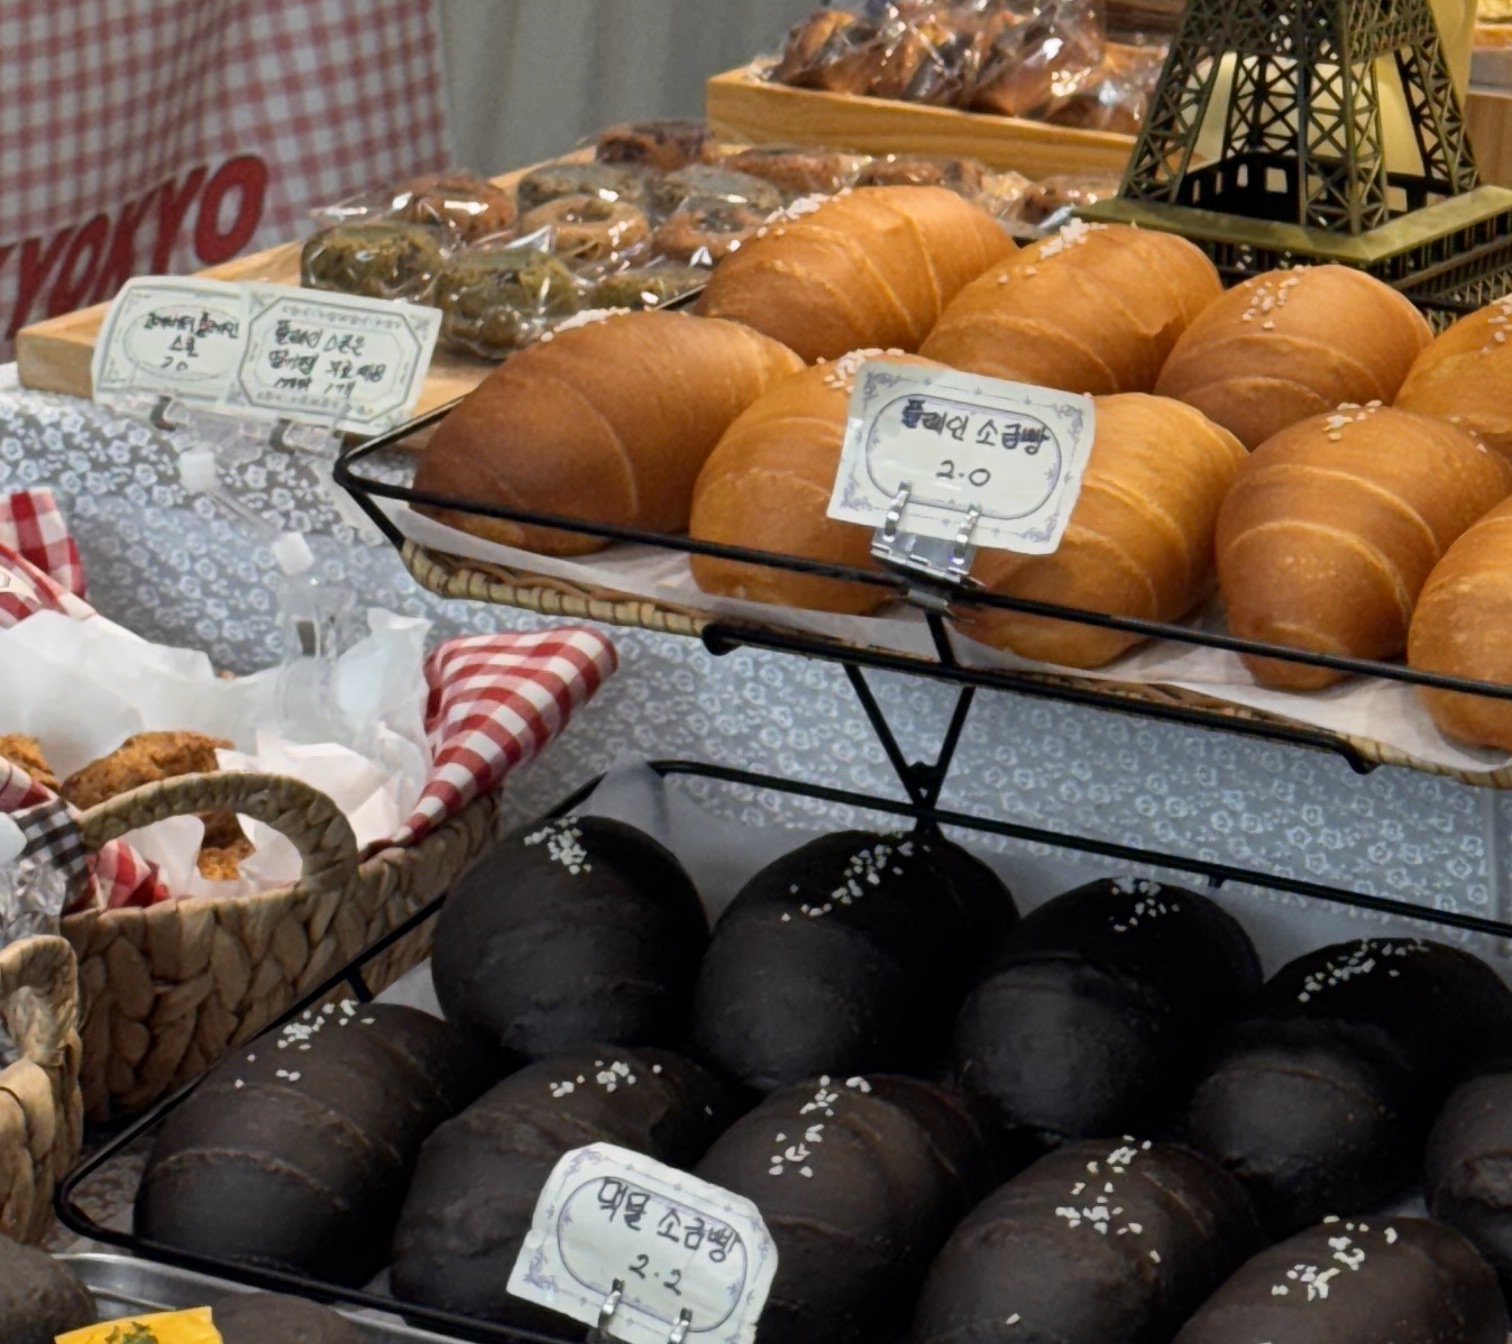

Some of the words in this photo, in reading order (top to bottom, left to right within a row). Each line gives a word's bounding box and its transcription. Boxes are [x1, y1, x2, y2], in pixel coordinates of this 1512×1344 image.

[900, 398, 971, 442] 플레인
[976, 418, 1051, 456] 소금빵
[935, 459, 992, 488] 2.0
[597, 1179, 651, 1232] 먹물
[656, 1206, 742, 1264] 소금빵
[628, 1253, 683, 1297] 2.2
